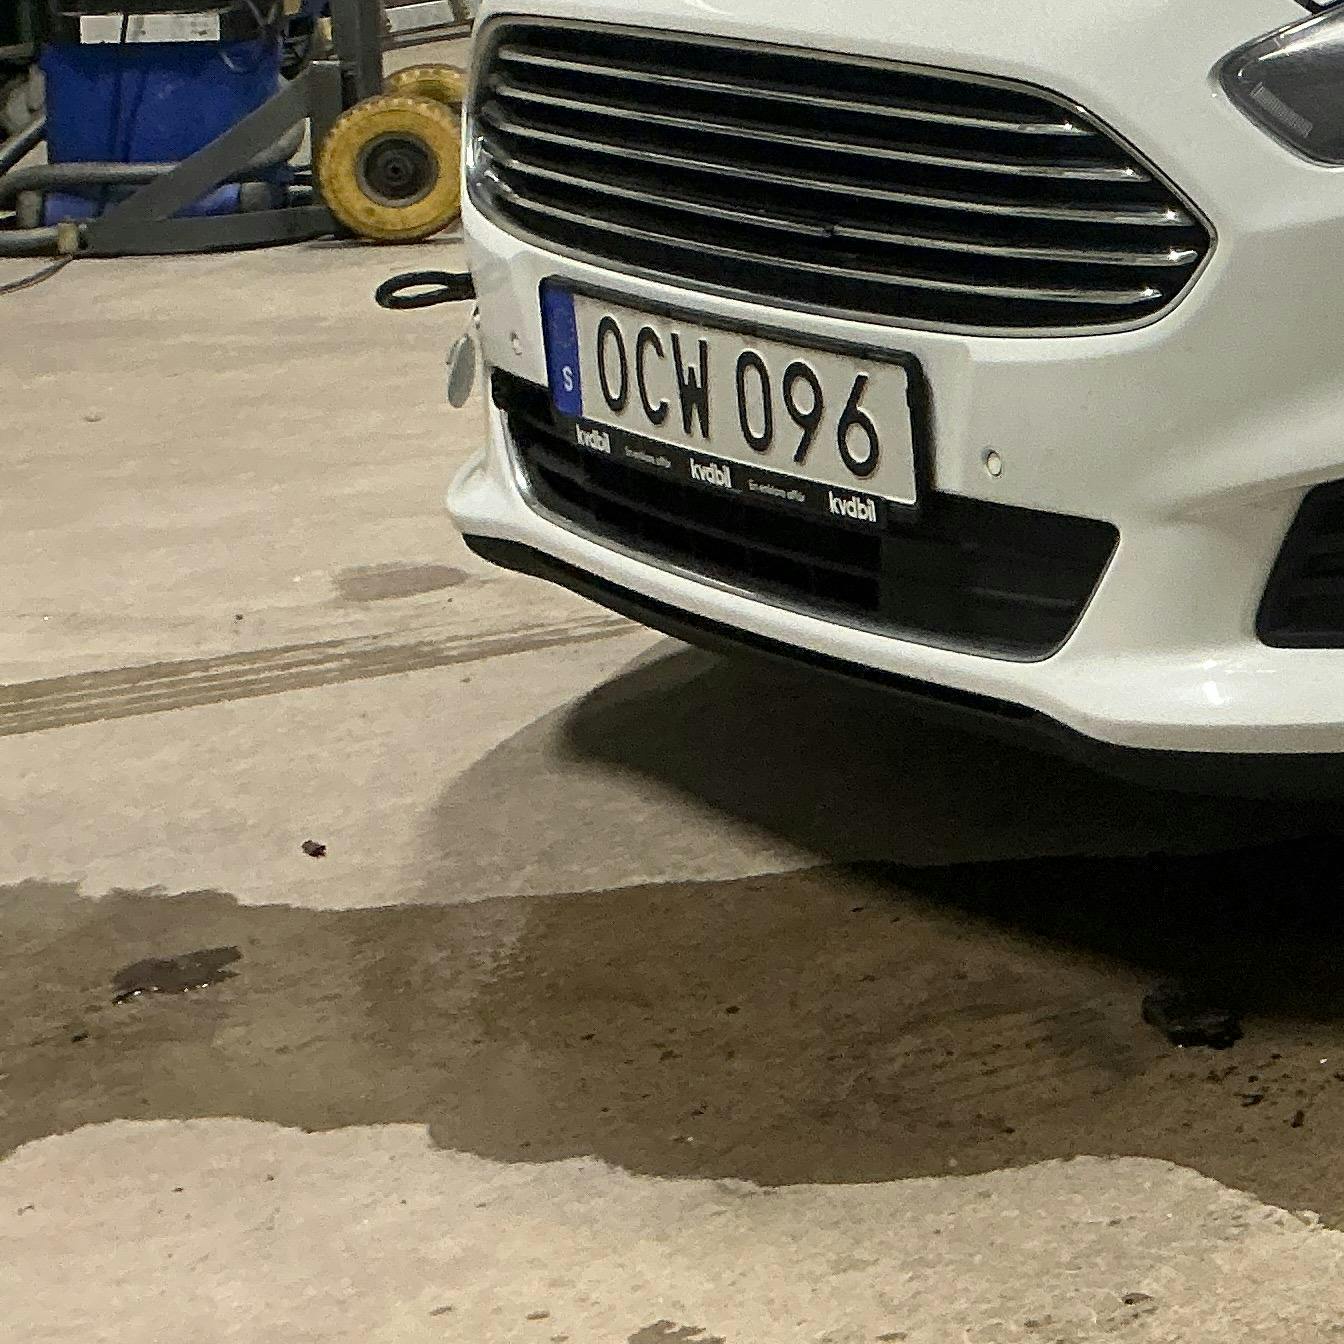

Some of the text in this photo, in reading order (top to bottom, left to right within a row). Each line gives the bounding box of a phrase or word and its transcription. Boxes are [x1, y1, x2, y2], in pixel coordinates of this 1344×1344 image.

[562, 366, 573, 392] S
[597, 316, 879, 477] OCW 096
[690, 457, 732, 488] kvdbil
[828, 490, 877, 523] kvdbil
